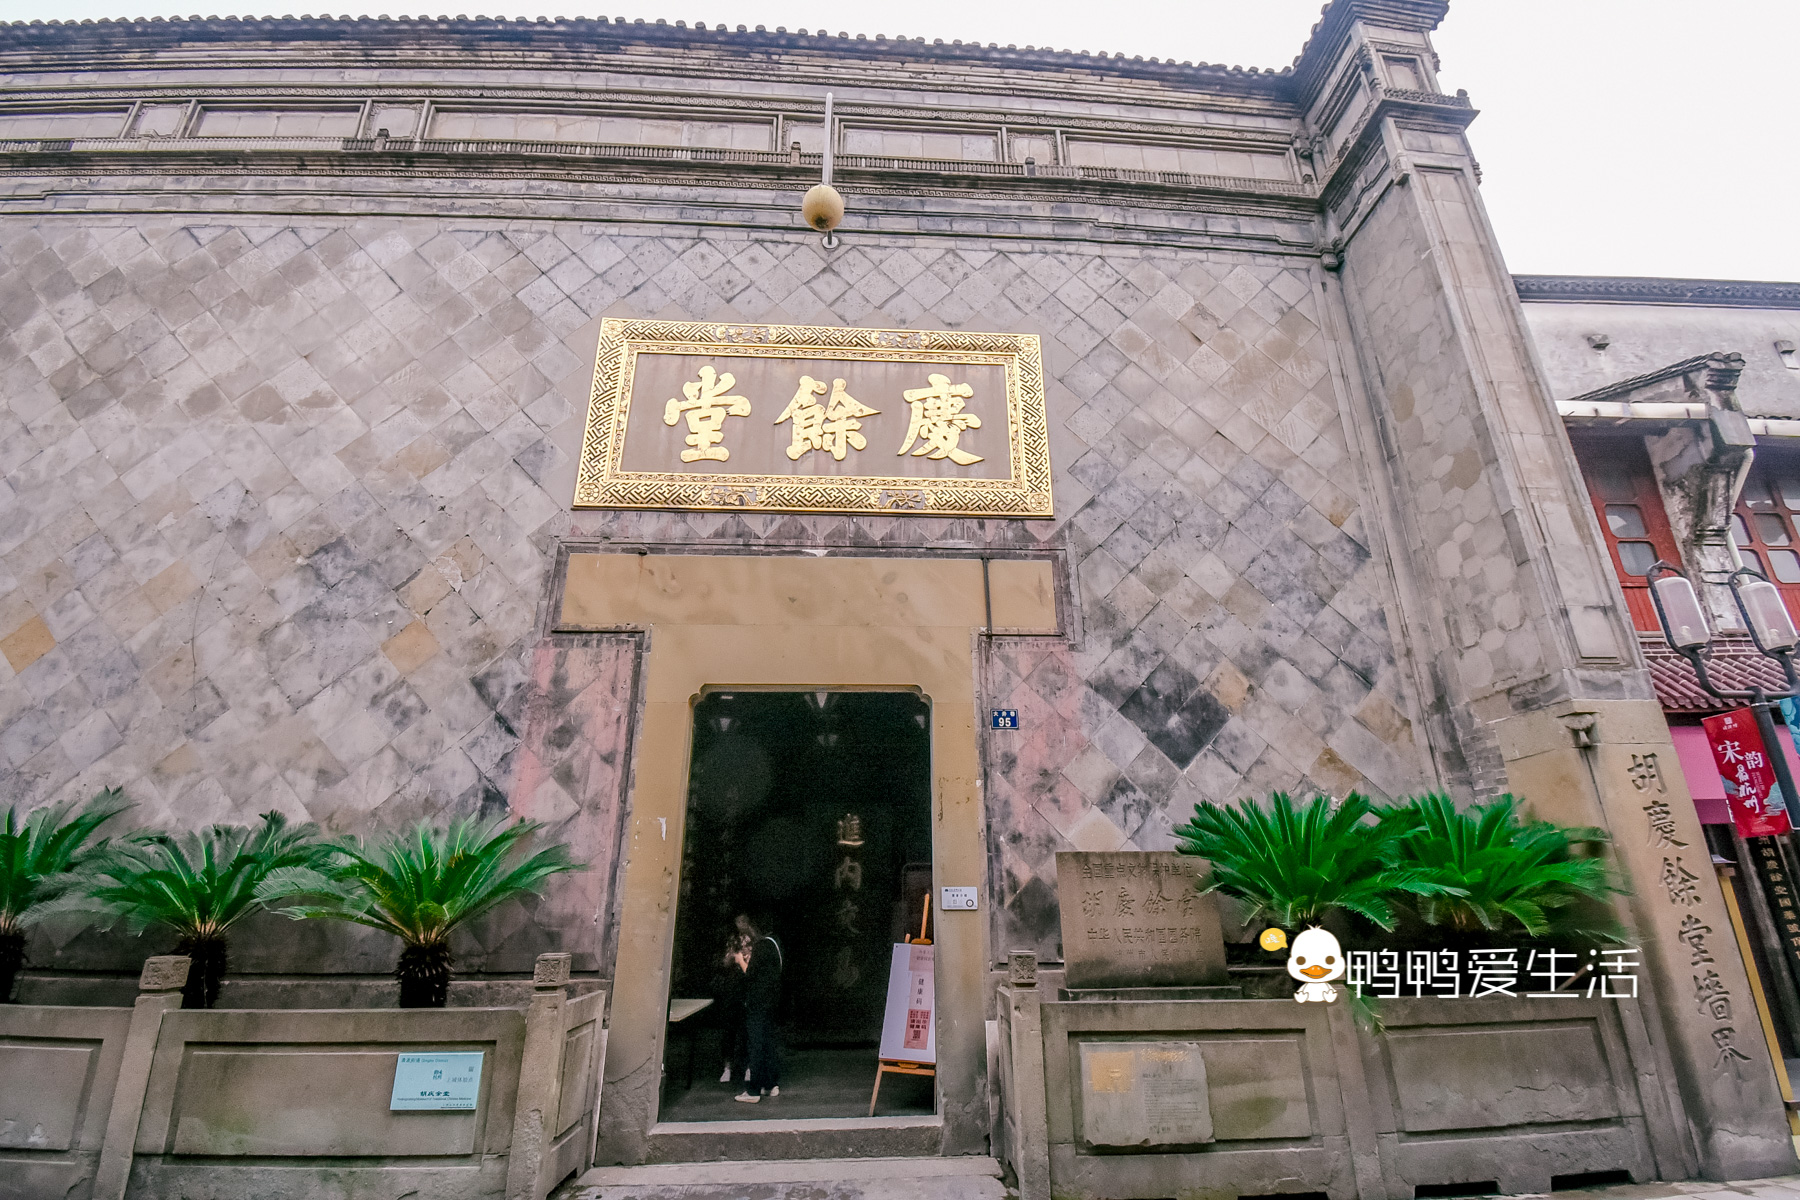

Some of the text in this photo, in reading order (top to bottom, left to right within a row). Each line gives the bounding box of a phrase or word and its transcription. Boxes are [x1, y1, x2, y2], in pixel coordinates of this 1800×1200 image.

[663, 365, 984, 466] 慶餘堂
[998, 717, 1011, 727] 95
